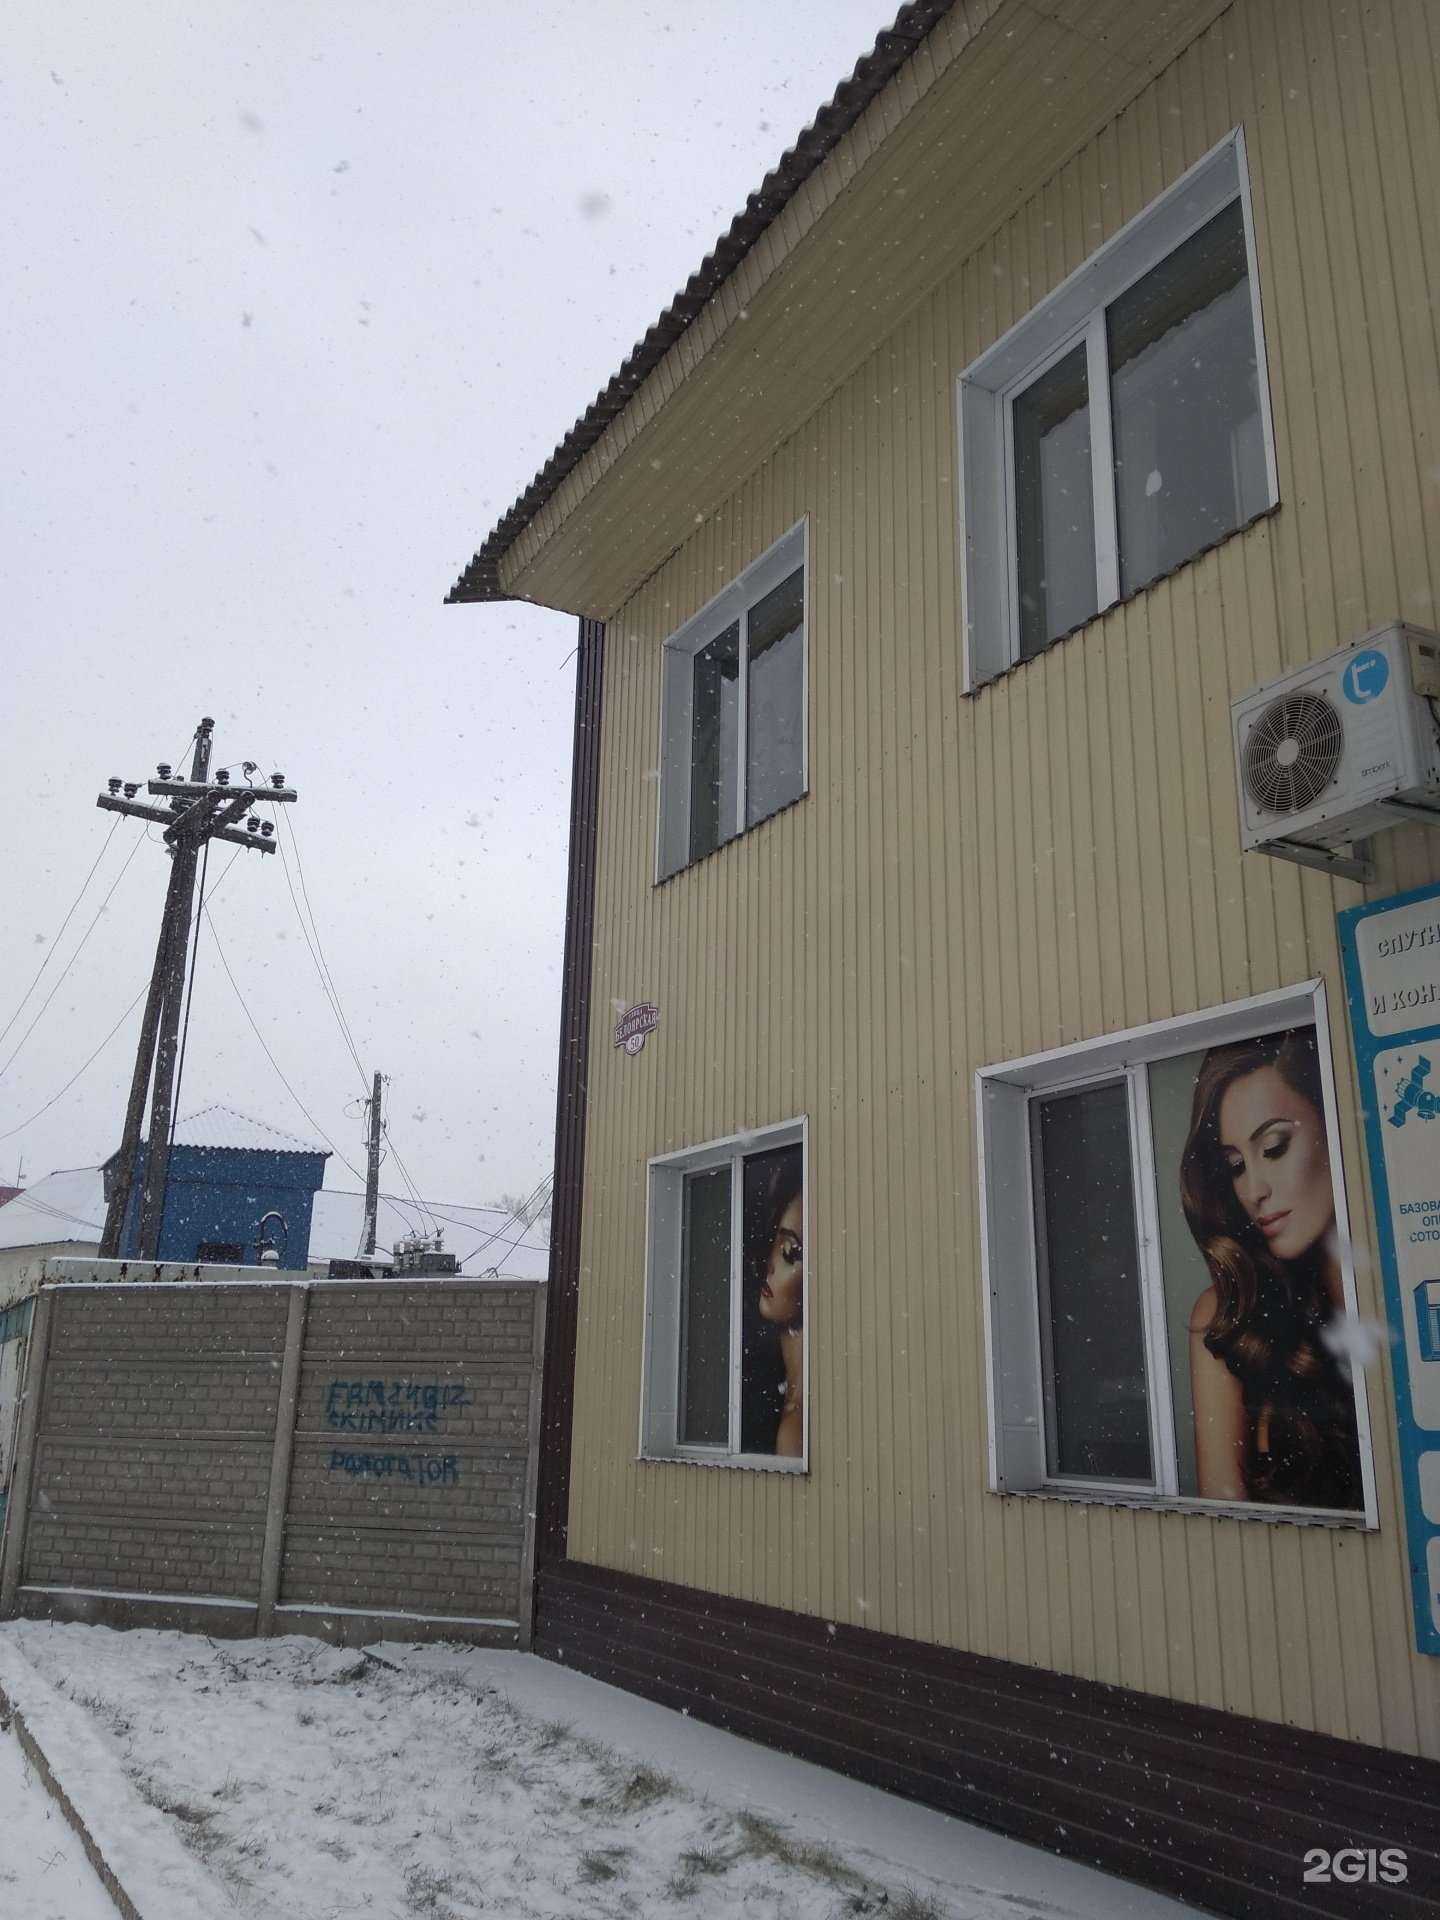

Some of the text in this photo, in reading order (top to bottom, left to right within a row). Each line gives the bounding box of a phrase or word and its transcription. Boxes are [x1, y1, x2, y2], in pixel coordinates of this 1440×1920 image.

[1373, 994, 1387, 1015] И
[1423, 1215, 1440, 1227] ОП
[1410, 1230, 1440, 1242] СОТО
